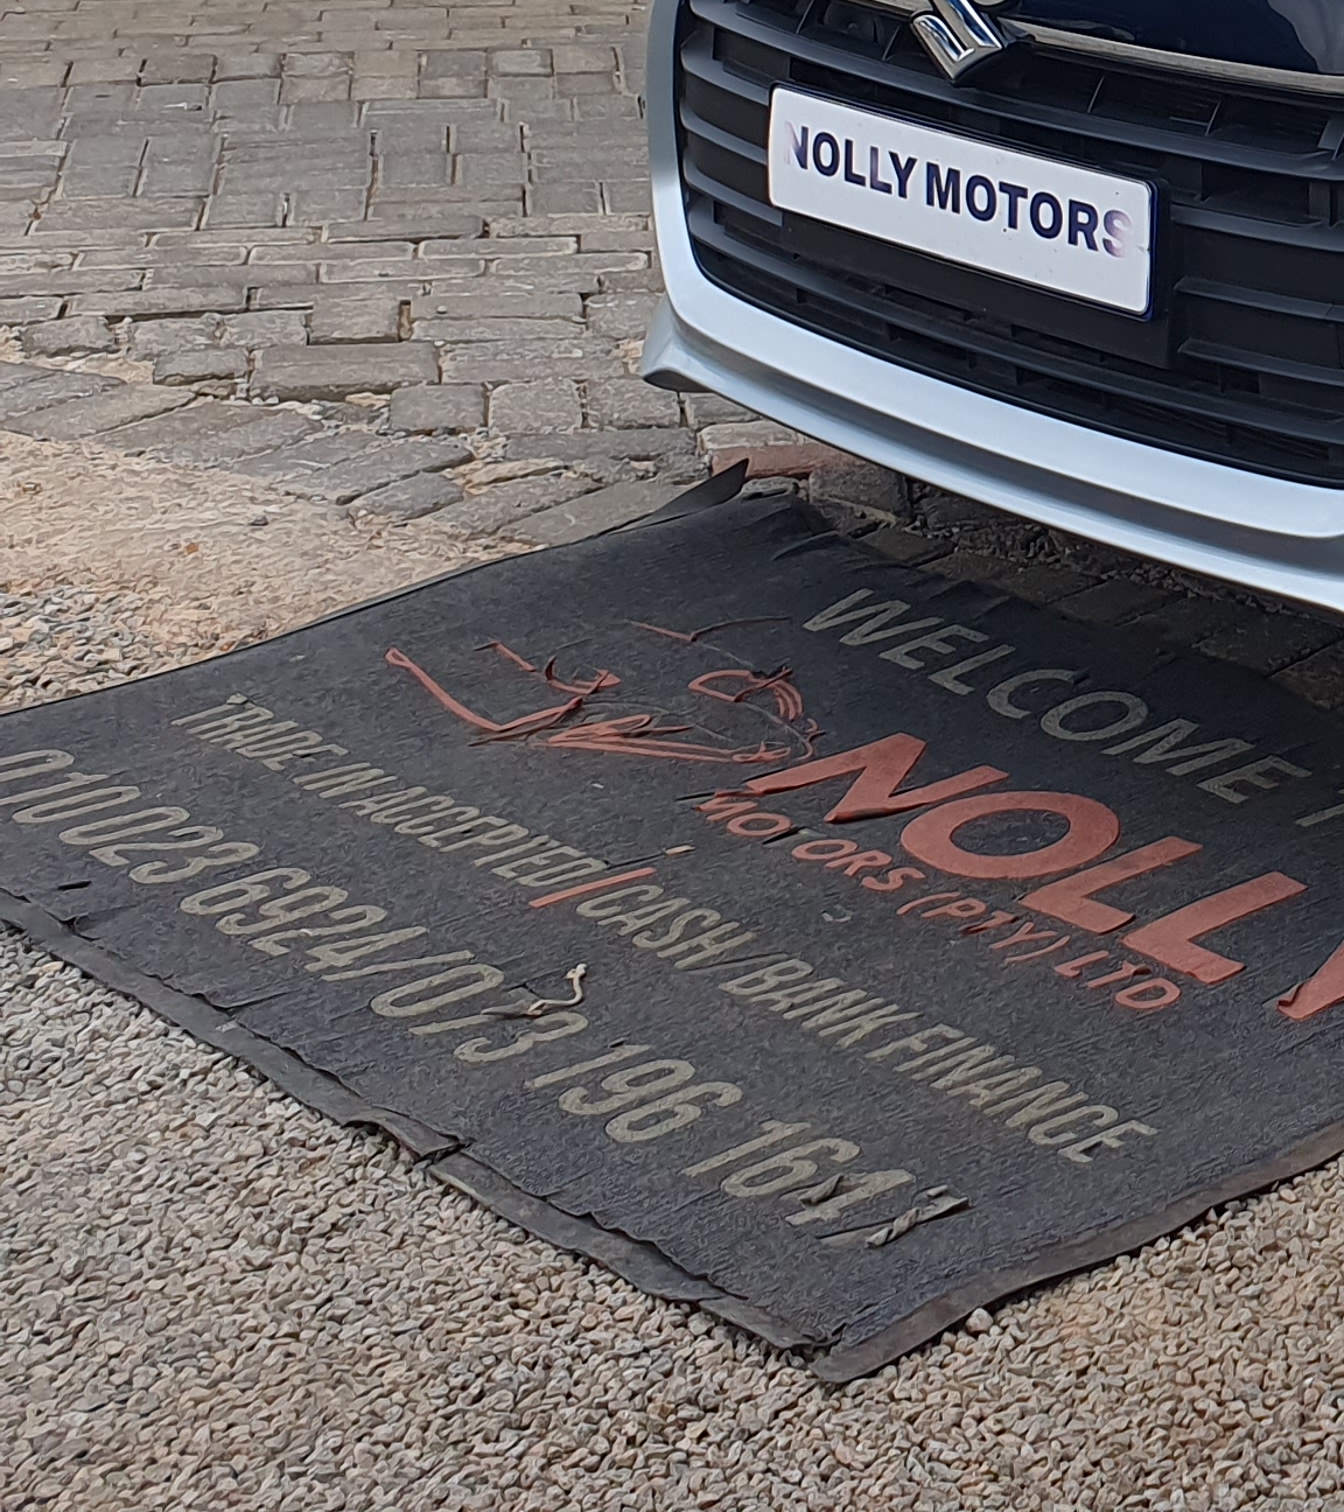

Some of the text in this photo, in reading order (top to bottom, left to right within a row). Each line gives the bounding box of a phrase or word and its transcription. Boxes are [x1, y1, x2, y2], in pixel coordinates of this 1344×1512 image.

[783, 120, 1133, 258] NOLLY MOTORS
[802, 588, 1312, 804] WELCOME
[59, 806, 261, 884] 023
[525, 1044, 743, 1144] 196
[170, 693, 350, 772] TRADE
[293, 762, 398, 798] IN
[864, 1023, 1158, 1163] FINANCE
[693, 791, 927, 891] MOORS
[1054, 950, 1181, 1010] LTD
